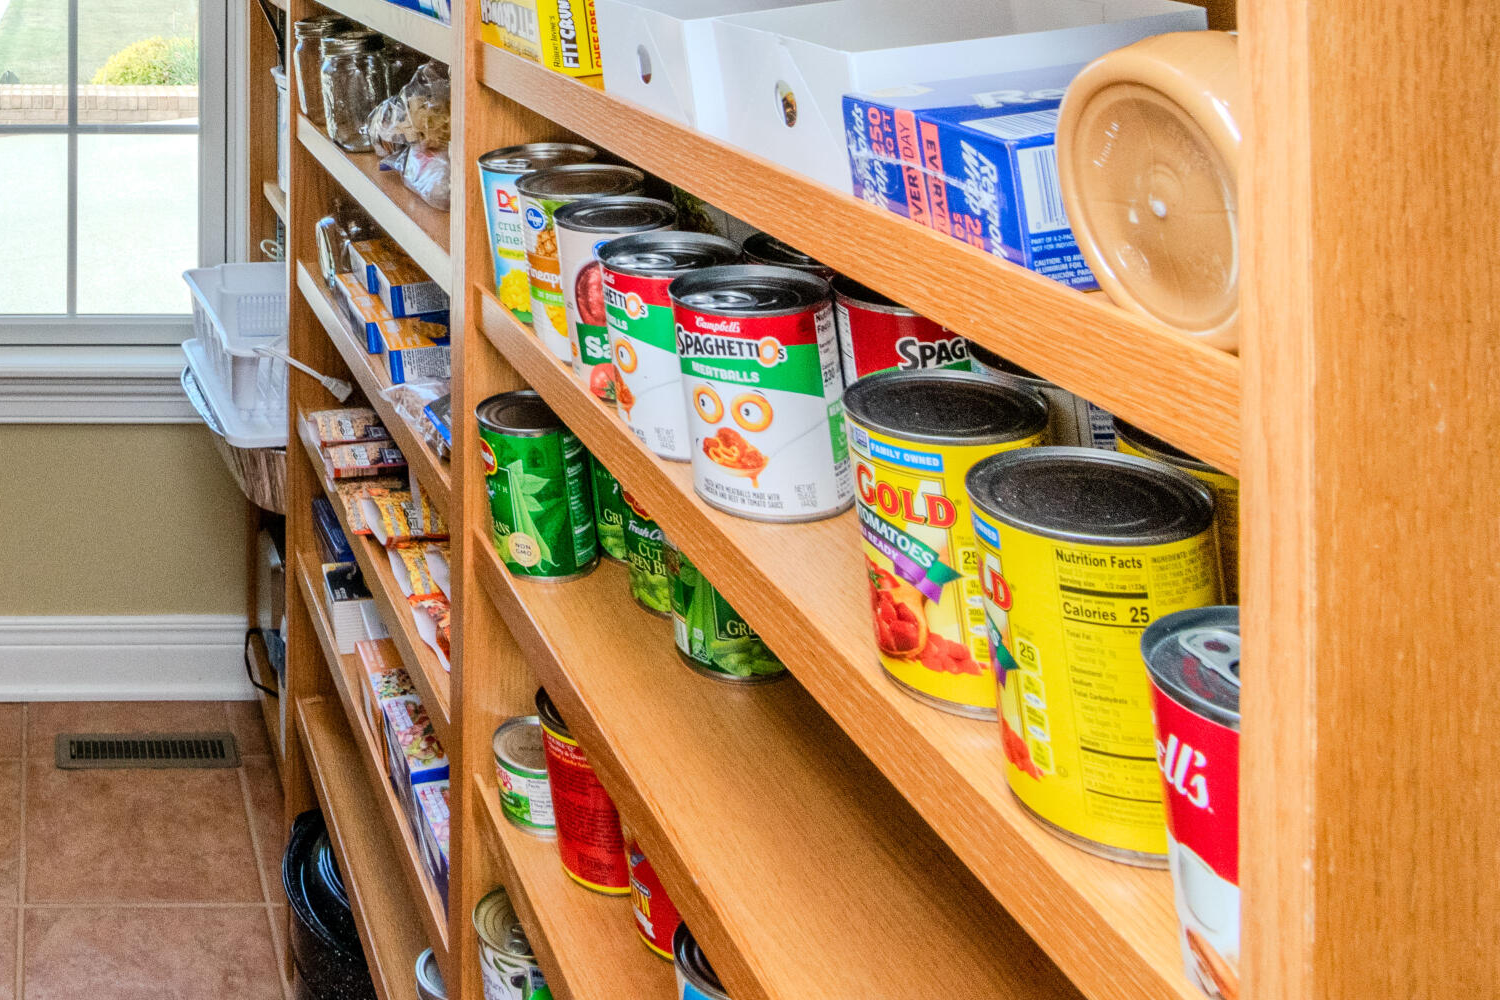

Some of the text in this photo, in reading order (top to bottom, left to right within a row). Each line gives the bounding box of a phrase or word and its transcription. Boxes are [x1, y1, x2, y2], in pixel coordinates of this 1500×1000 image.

[560, 36, 581, 69] FIT
[694, 314, 741, 334] Campbell's
[691, 360, 760, 384] MEATBALLS
[869, 439, 941, 468] FAMILY OWNED
[855, 462, 958, 530] GOLD
[858, 508, 936, 569] TOMATOES
[638, 541, 663, 562] CUT
[1055, 548, 1144, 571] Nutrition Facts
[1063, 602, 1151, 624] Calories 25
[1019, 646, 1036, 662] 25
